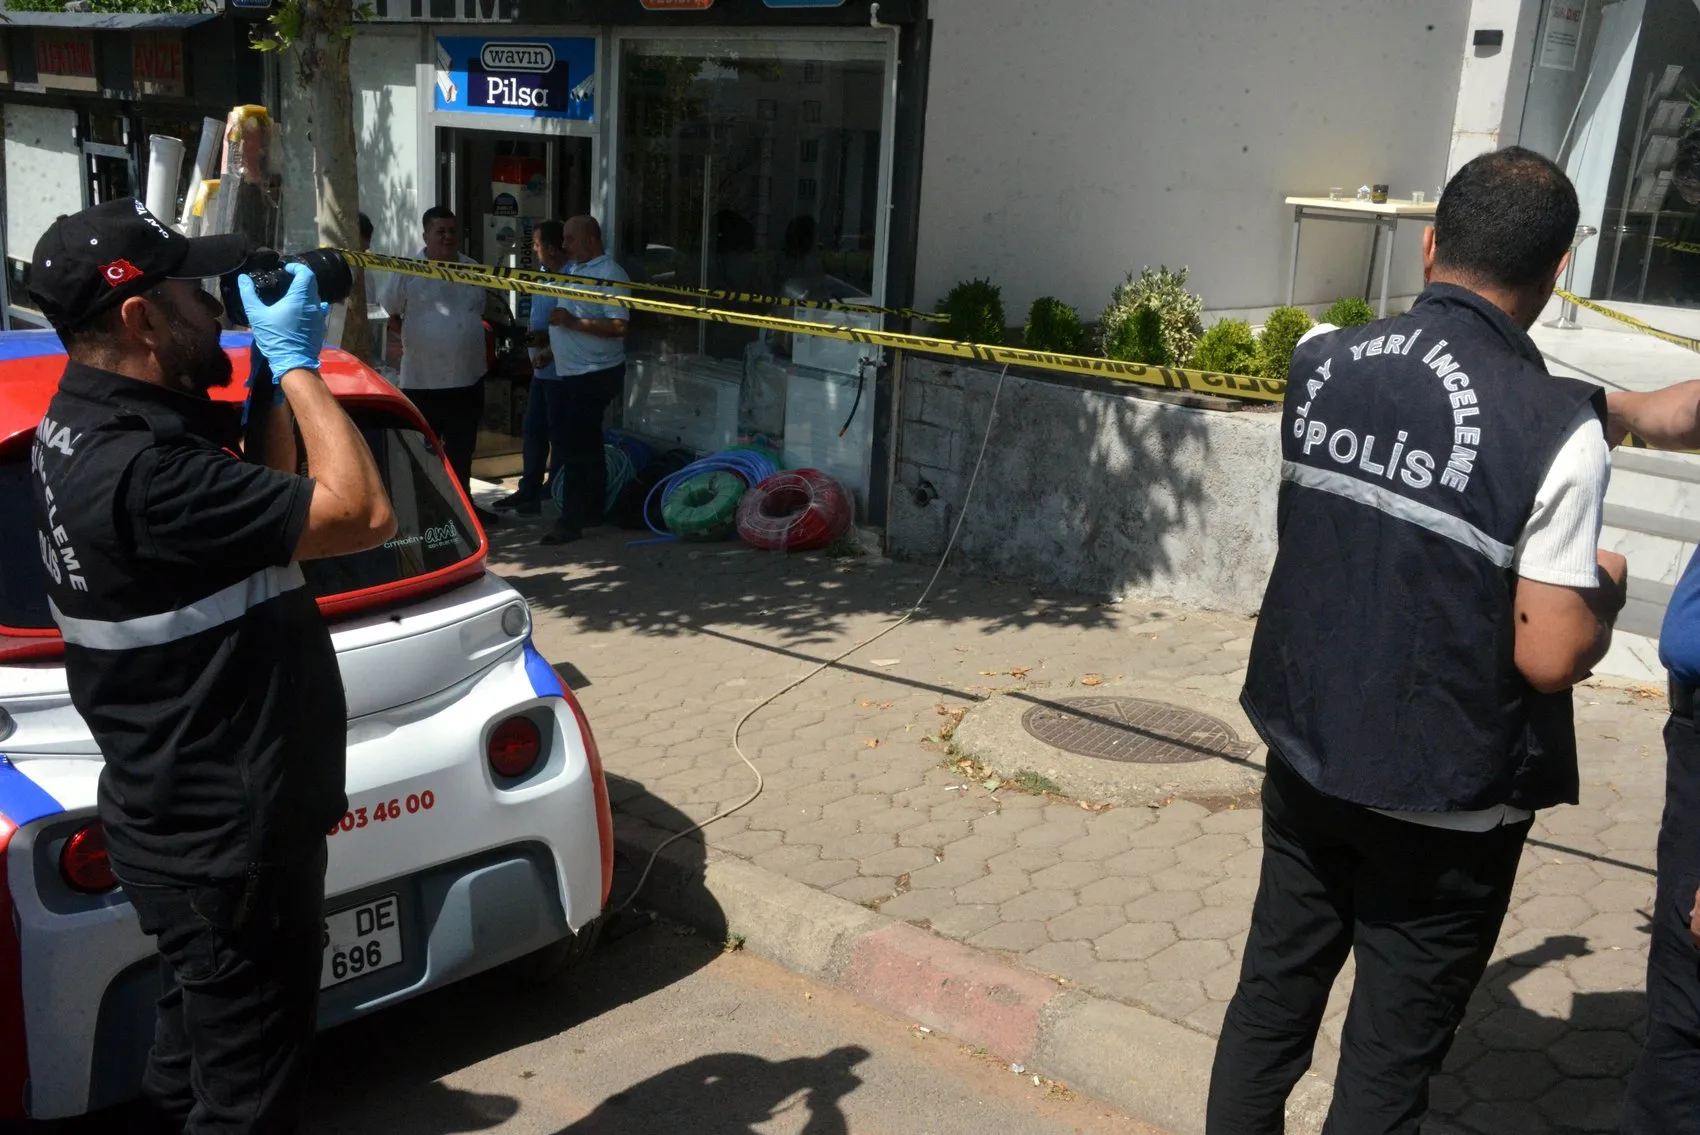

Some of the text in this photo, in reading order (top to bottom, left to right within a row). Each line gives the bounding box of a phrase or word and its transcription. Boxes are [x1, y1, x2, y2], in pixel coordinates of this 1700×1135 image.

[486, 76, 549, 107] Pilsa
[1293, 328, 1481, 494] OLAY YERİ İNCELEME
[1303, 420, 1435, 489] POLİS
[424, 519, 457, 544] ami
[373, 798, 402, 823] 46
[405, 789, 436, 814] 00
[355, 899, 395, 938] DE
[331, 940, 382, 980] 696
